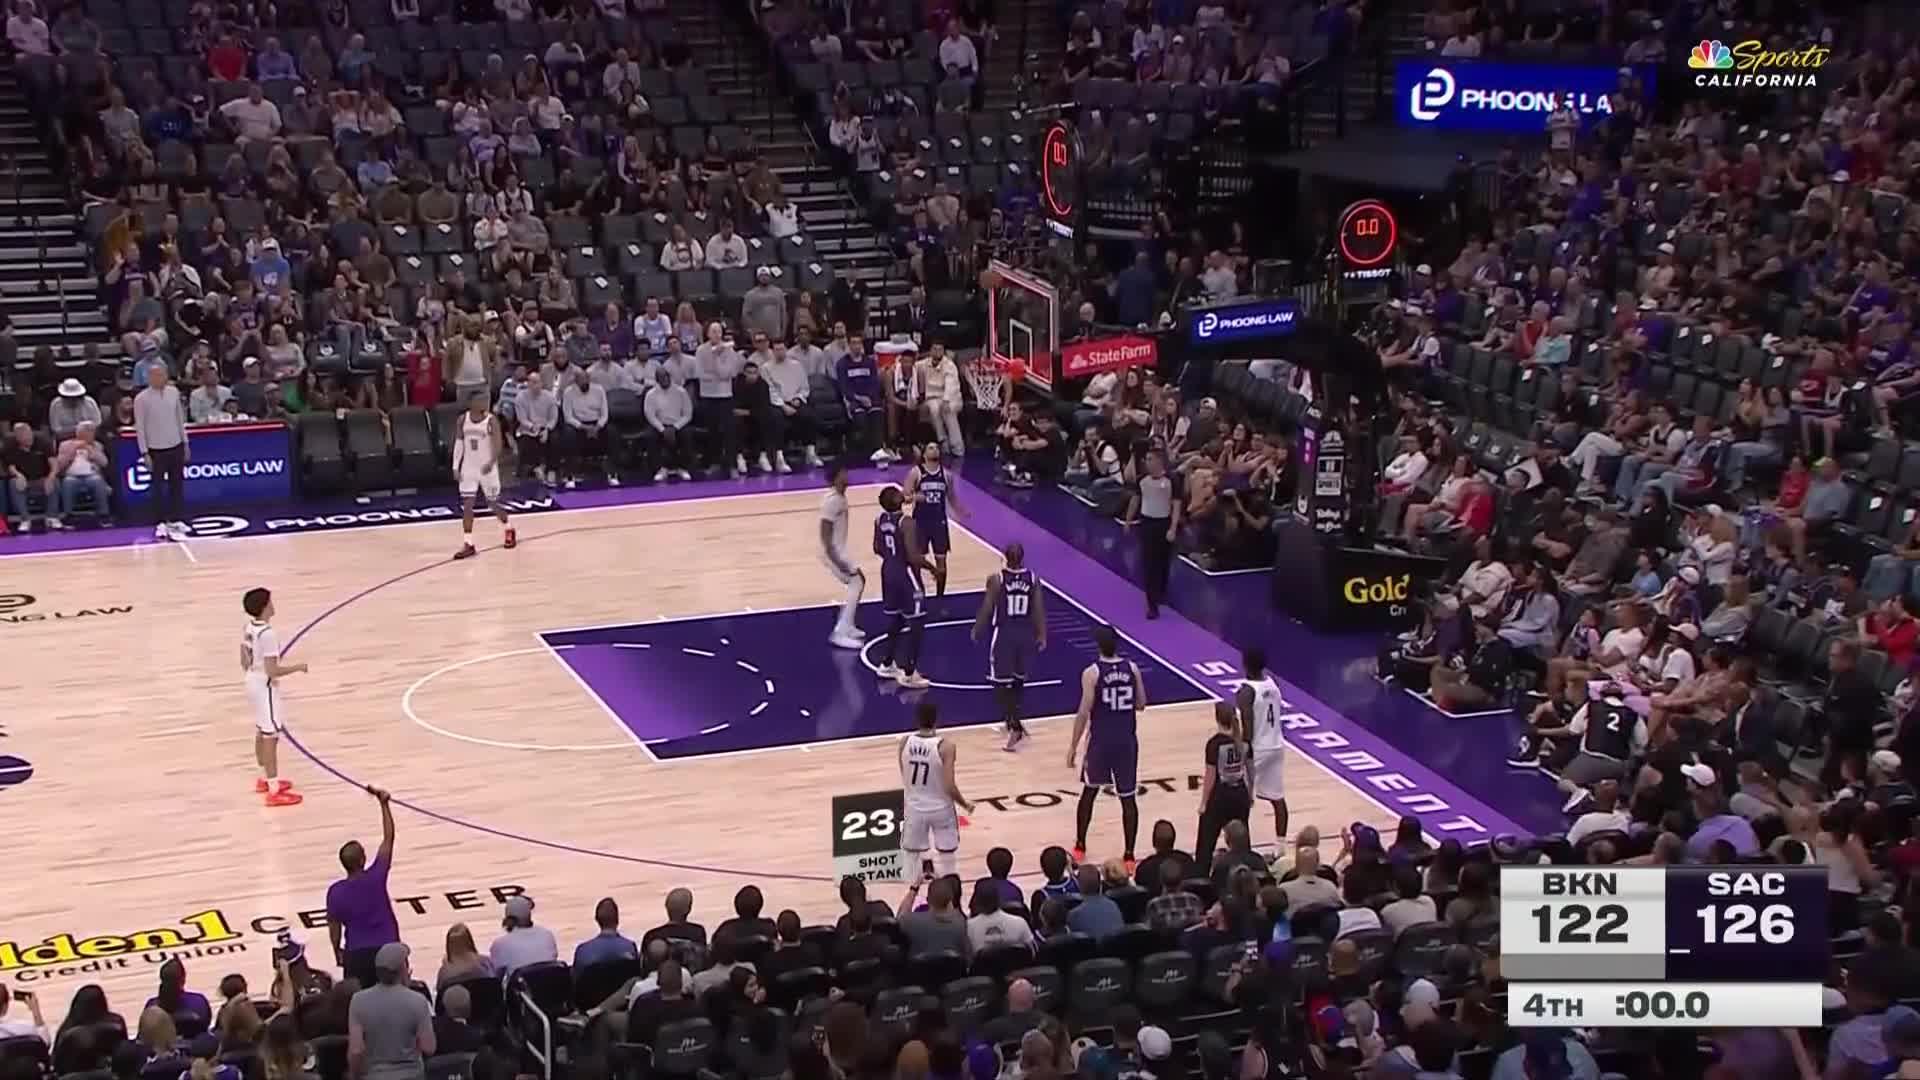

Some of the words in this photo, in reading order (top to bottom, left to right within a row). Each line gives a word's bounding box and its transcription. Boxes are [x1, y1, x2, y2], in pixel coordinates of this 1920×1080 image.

[1357, 219, 1379, 236] 0.0
[1220, 316, 1267, 329] PHOONG
[1268, 311, 1295, 323] LAW
[243, 459, 284, 475] LAW
[926, 491, 941, 503] 22
[266, 505, 454, 530] PHOONG
[885, 535, 896, 556] 9
[54, 605, 133, 619] LAW
[1007, 594, 1029, 616] 10
[1102, 685, 1134, 711] 42
[1266, 703, 1275, 728] 4
[1606, 712, 1621, 732] 2
[909, 760, 930, 786] 77
[250, 884, 536, 934] CETER
[15, 957, 130, 982] Credit
[143, 942, 248, 963] Union
